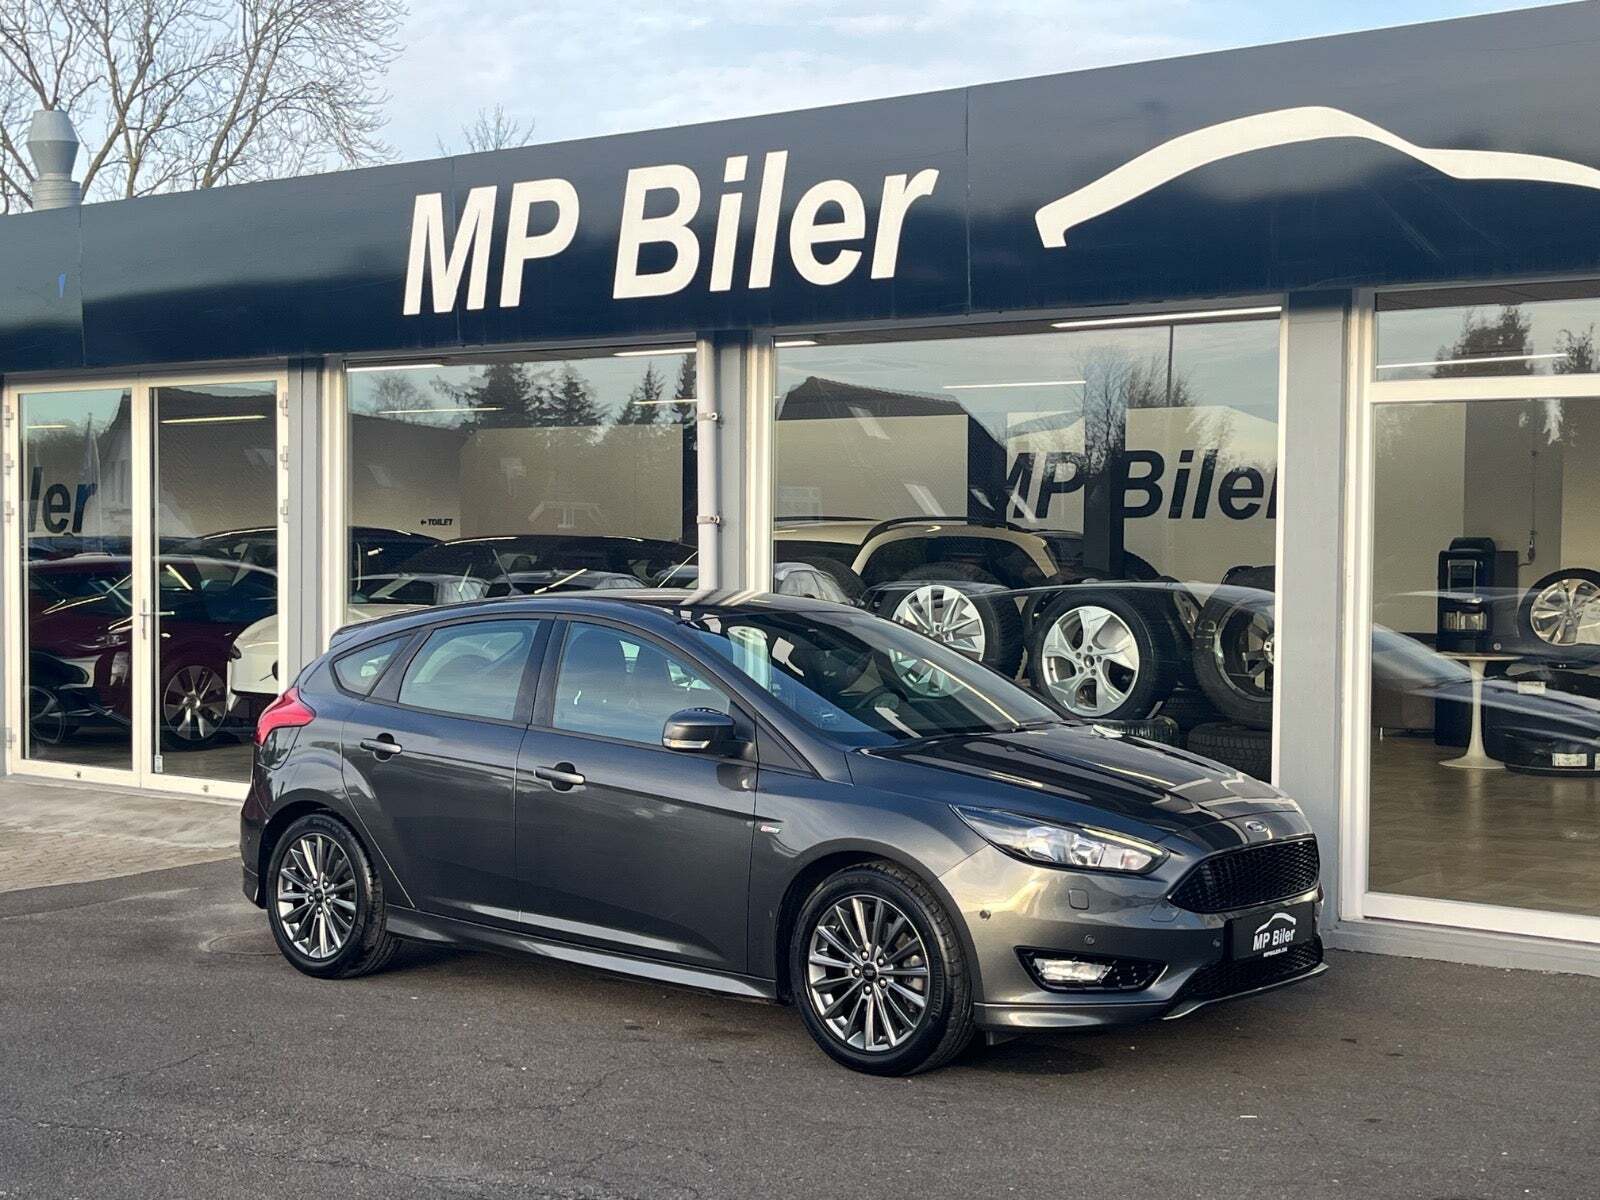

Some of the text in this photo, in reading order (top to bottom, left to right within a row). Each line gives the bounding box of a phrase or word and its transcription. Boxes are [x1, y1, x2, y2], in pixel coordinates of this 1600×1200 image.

[402, 150, 940, 315] MP Biler
[427, 518, 453, 526] TOILET
[1252, 927, 1296, 951] MP Biler
